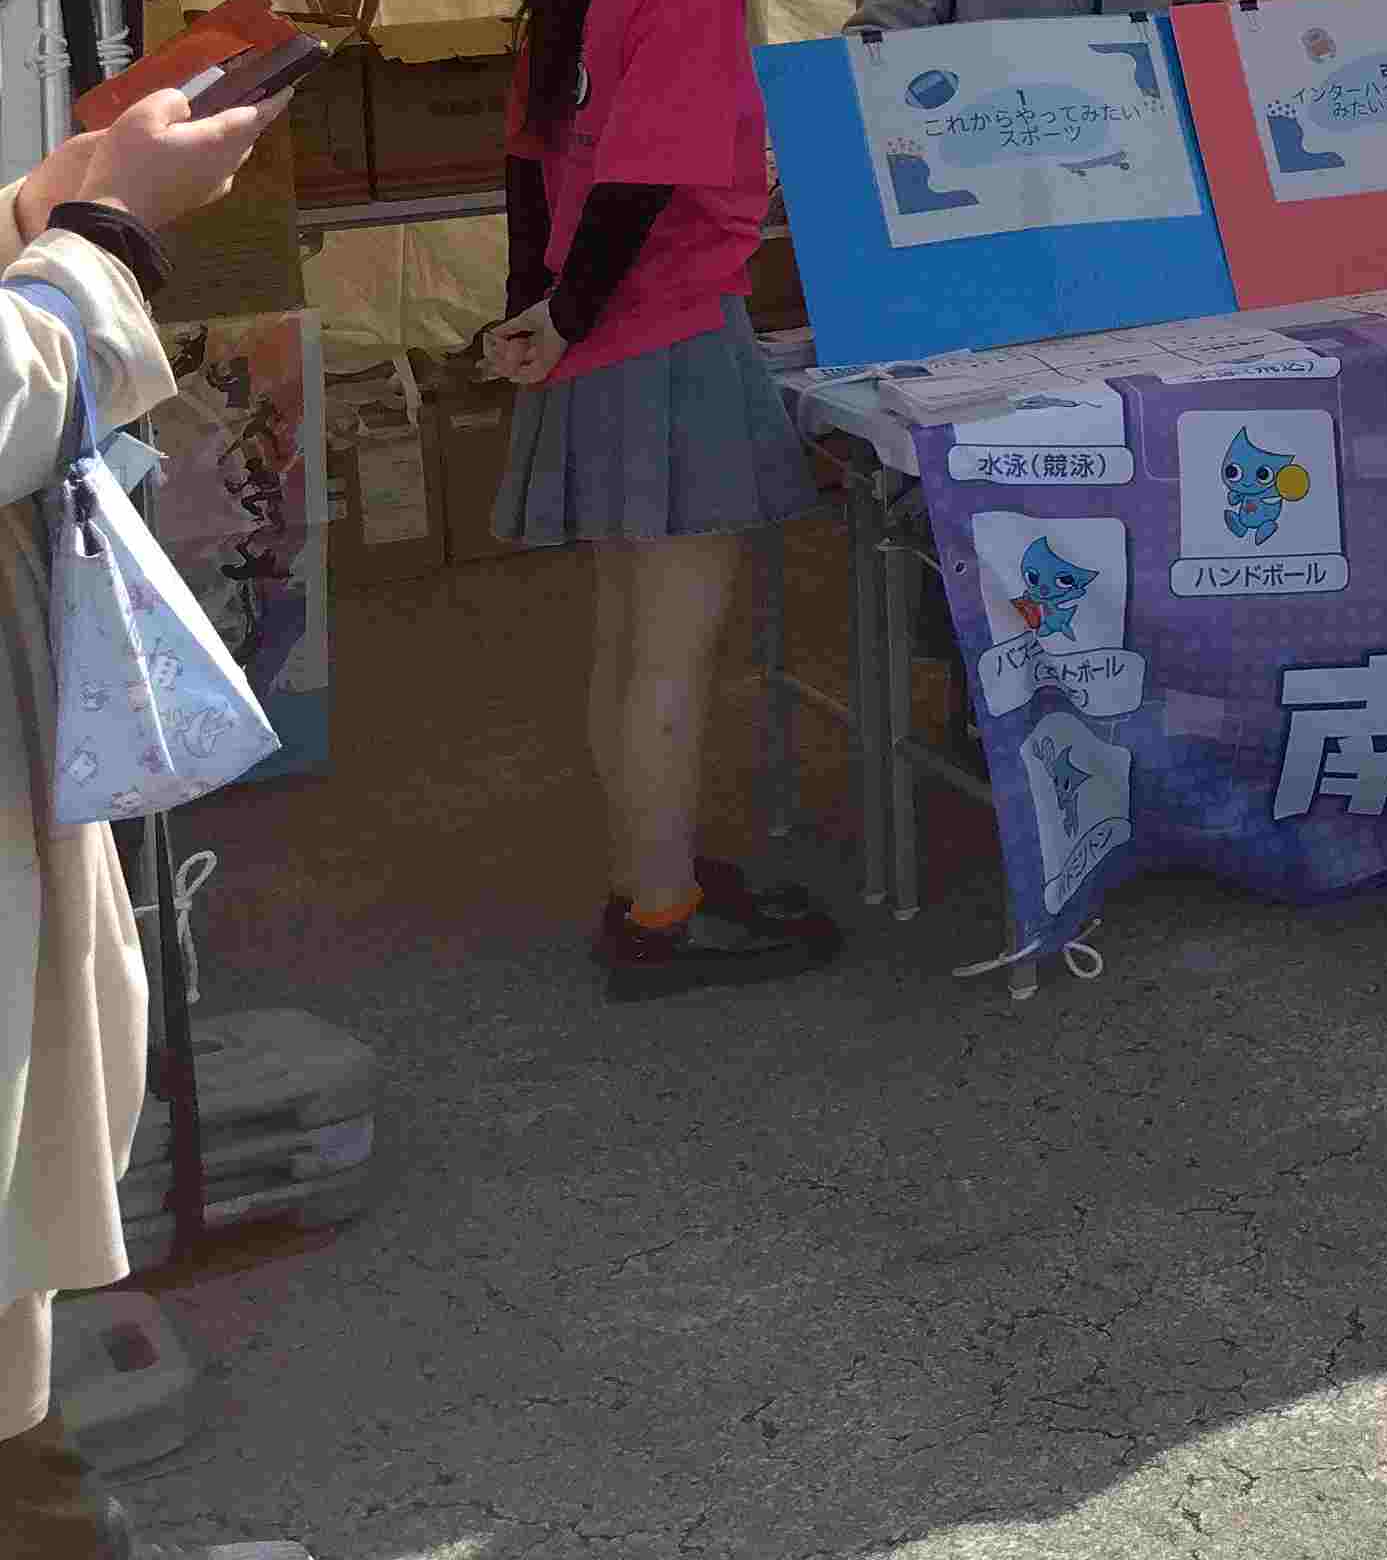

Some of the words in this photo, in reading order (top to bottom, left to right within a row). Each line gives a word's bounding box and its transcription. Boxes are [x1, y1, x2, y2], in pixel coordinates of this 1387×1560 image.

[1016, 89, 1027, 106] 1
[925, 103, 1143, 138] これからやってみたい
[1000, 125, 1081, 147] スポーツ
[976, 452, 1107, 479] 水泳(競泳)
[1194, 560, 1327, 589] ハンドボール
